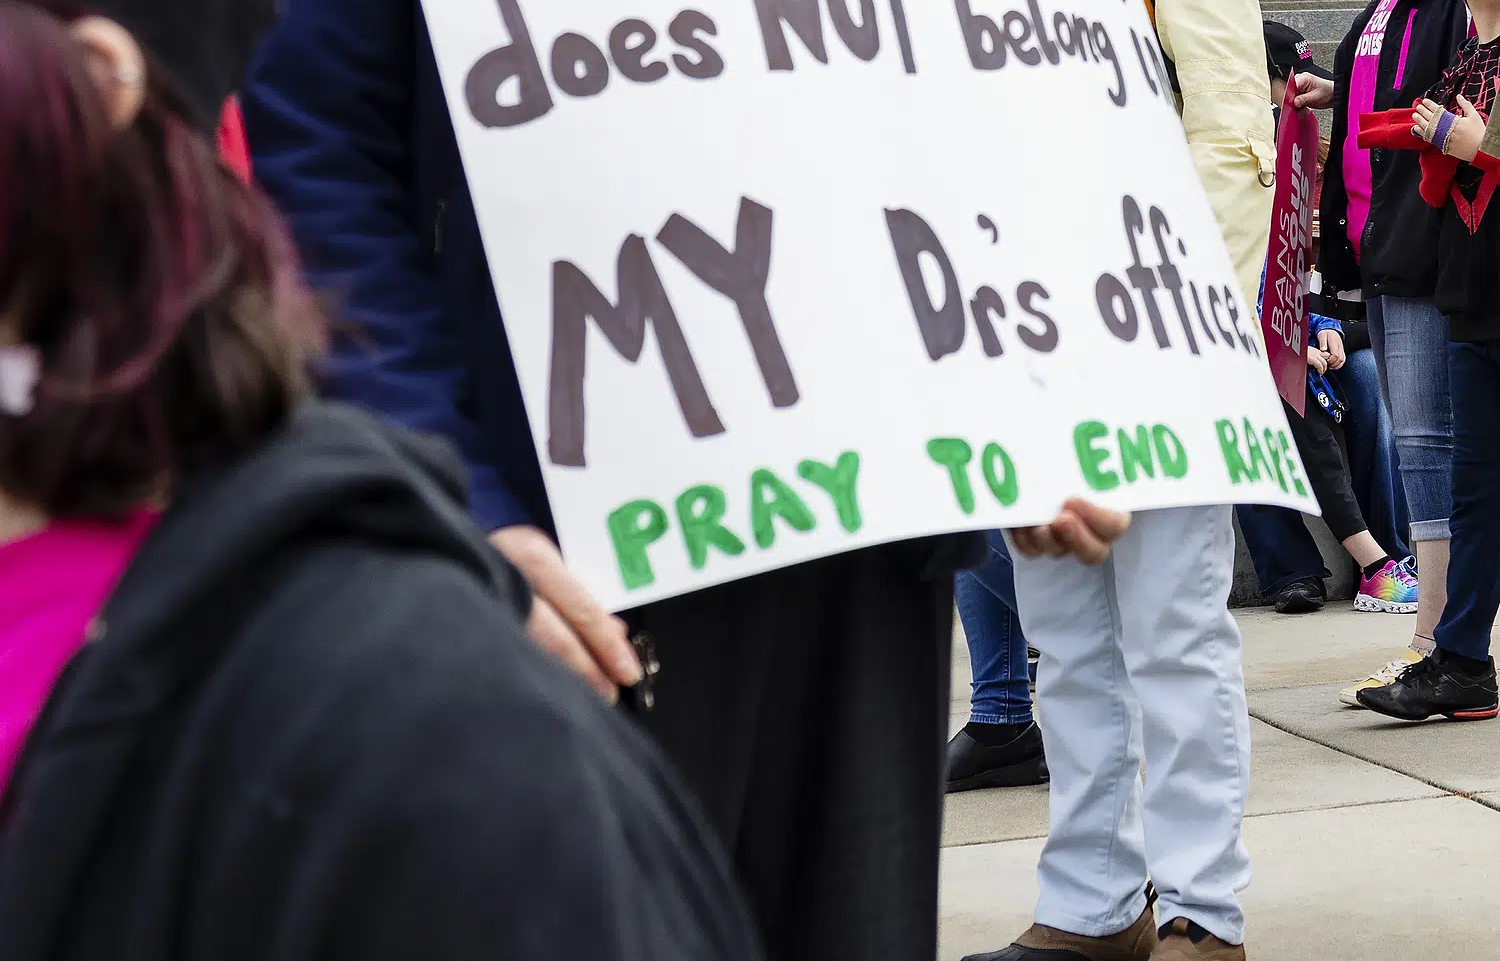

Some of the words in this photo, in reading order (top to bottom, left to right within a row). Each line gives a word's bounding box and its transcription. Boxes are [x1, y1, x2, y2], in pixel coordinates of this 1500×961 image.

[547, 194, 801, 469] MY
[1271, 207, 1290, 336] BANS
[1291, 168, 1311, 357] BODIES
[606, 450, 863, 591] PRAY
[926, 437, 1019, 516] TO
[1072, 419, 1189, 492] END
[1214, 416, 1309, 498] RAPE
